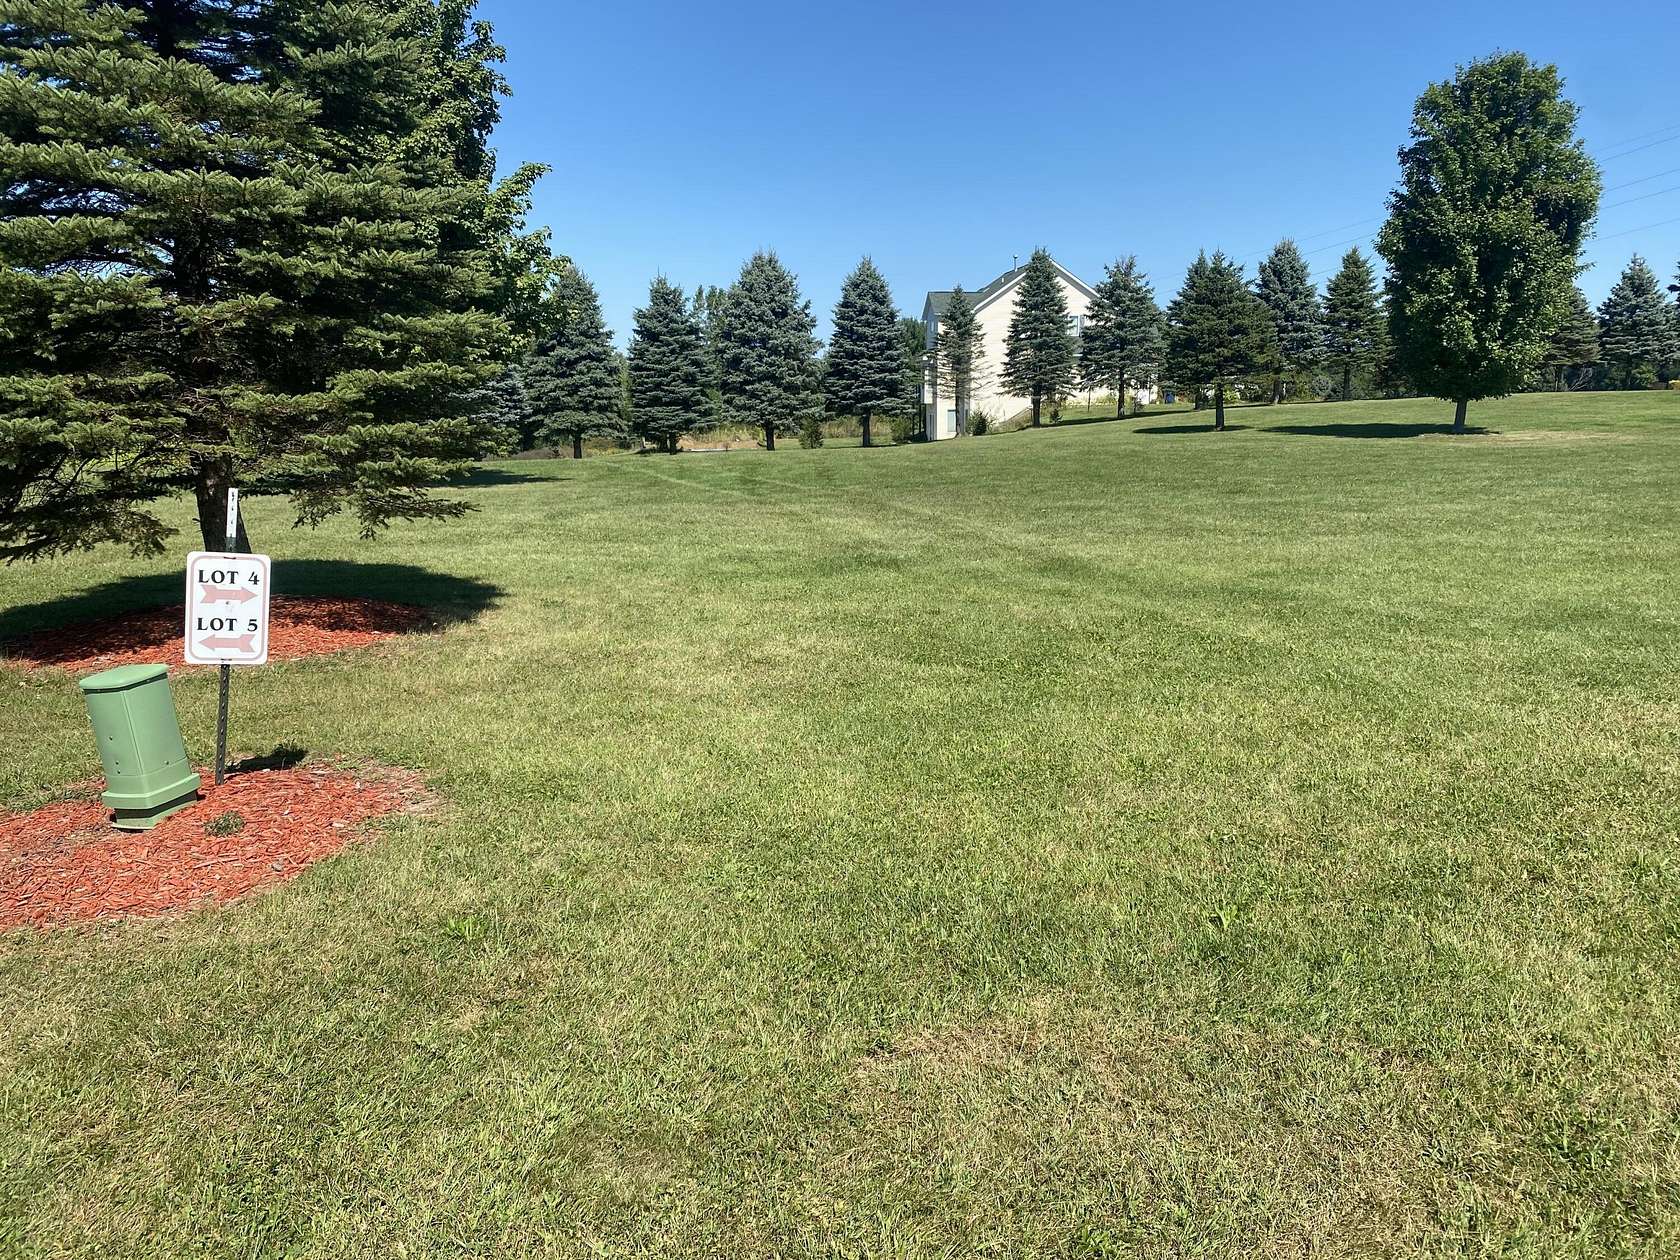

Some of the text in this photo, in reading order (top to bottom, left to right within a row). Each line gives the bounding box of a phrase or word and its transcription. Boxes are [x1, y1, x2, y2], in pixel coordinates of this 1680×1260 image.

[198, 569, 260, 585] LOT 4
[196, 617, 258, 632] LOT 5
